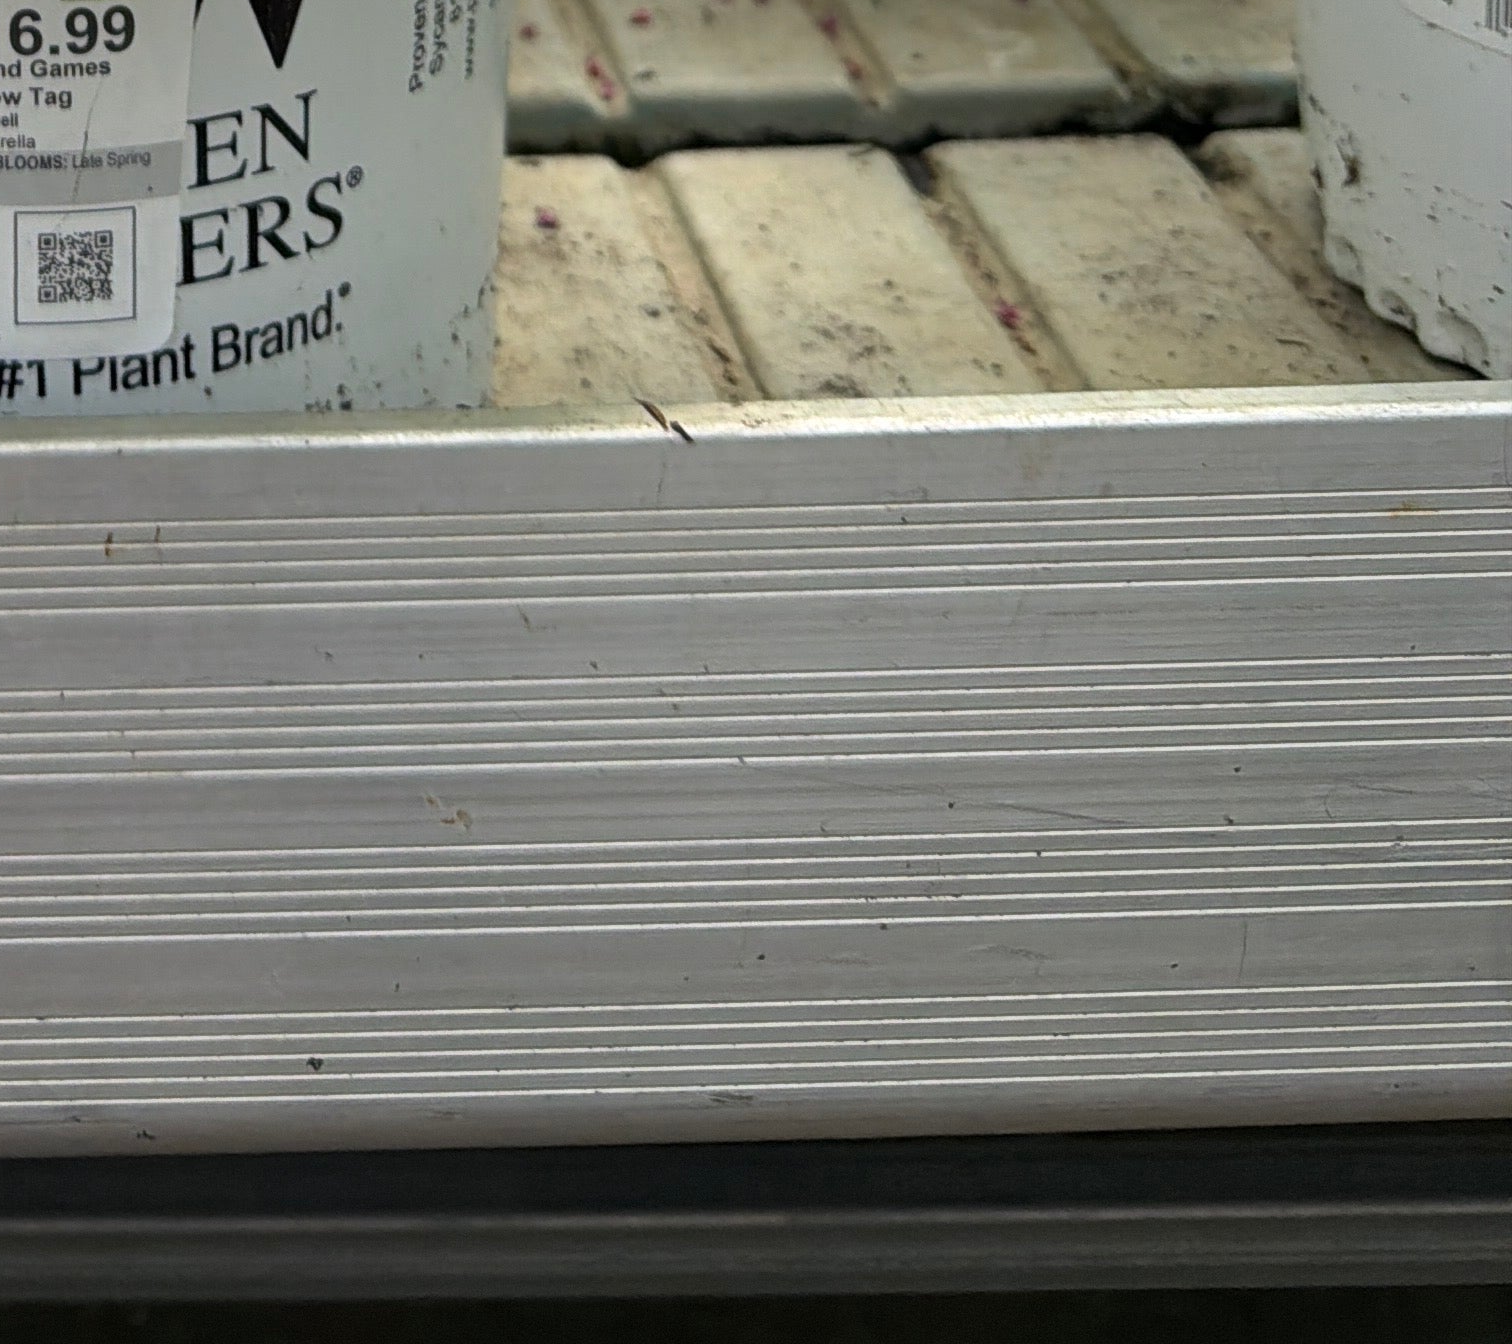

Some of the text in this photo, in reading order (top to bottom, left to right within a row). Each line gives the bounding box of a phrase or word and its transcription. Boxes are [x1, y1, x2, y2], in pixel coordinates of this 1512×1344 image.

[30, 59, 111, 78] Games
[29, 87, 73, 109] Tag
[72, 153, 103, 169] Late
[106, 150, 152, 169] Spring
